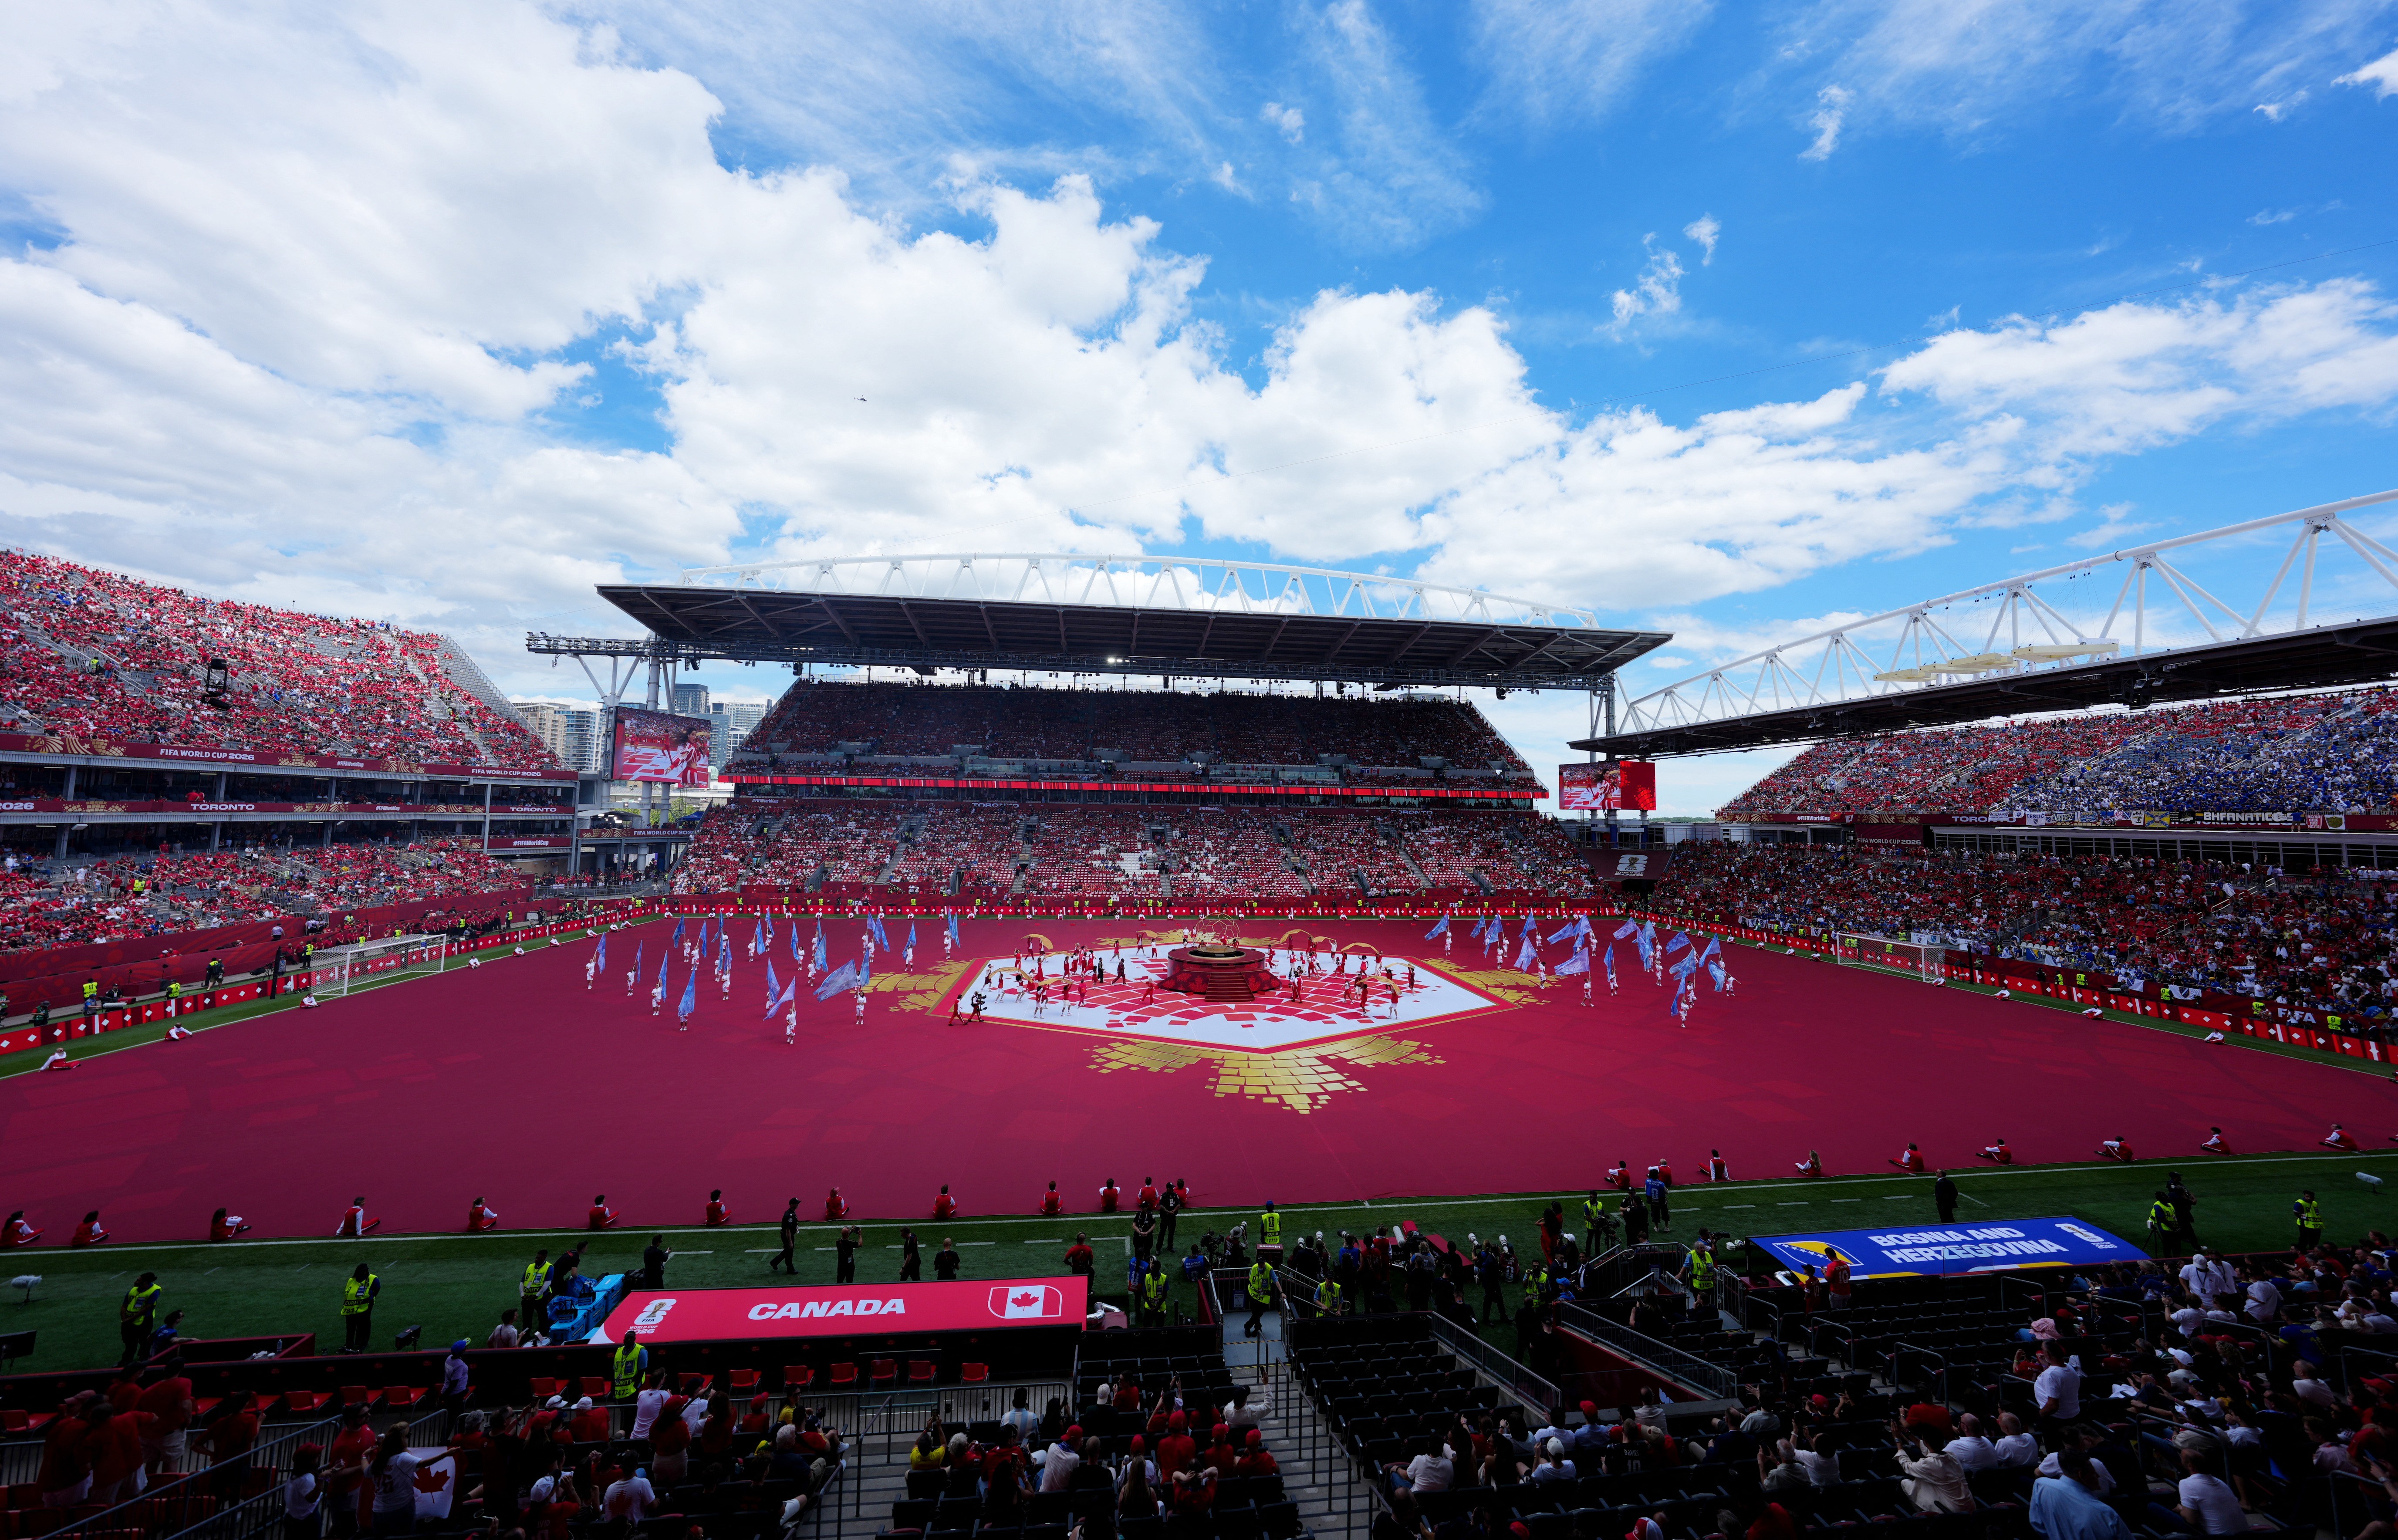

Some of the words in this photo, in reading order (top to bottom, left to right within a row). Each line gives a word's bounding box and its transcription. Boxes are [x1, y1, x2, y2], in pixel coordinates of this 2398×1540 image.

[180, 750, 211, 758] WORLD
[0, 802, 34, 810] 026
[2053, 813, 2073, 821] VITEZ
[2277, 1007, 2316, 1024] FFA
[1868, 1229, 1966, 1247] BOSNIA
[1967, 1226, 2025, 1240] AND
[1881, 1239, 2069, 1263] HERZEGOVINA
[747, 1298, 905, 1320] CANADA
